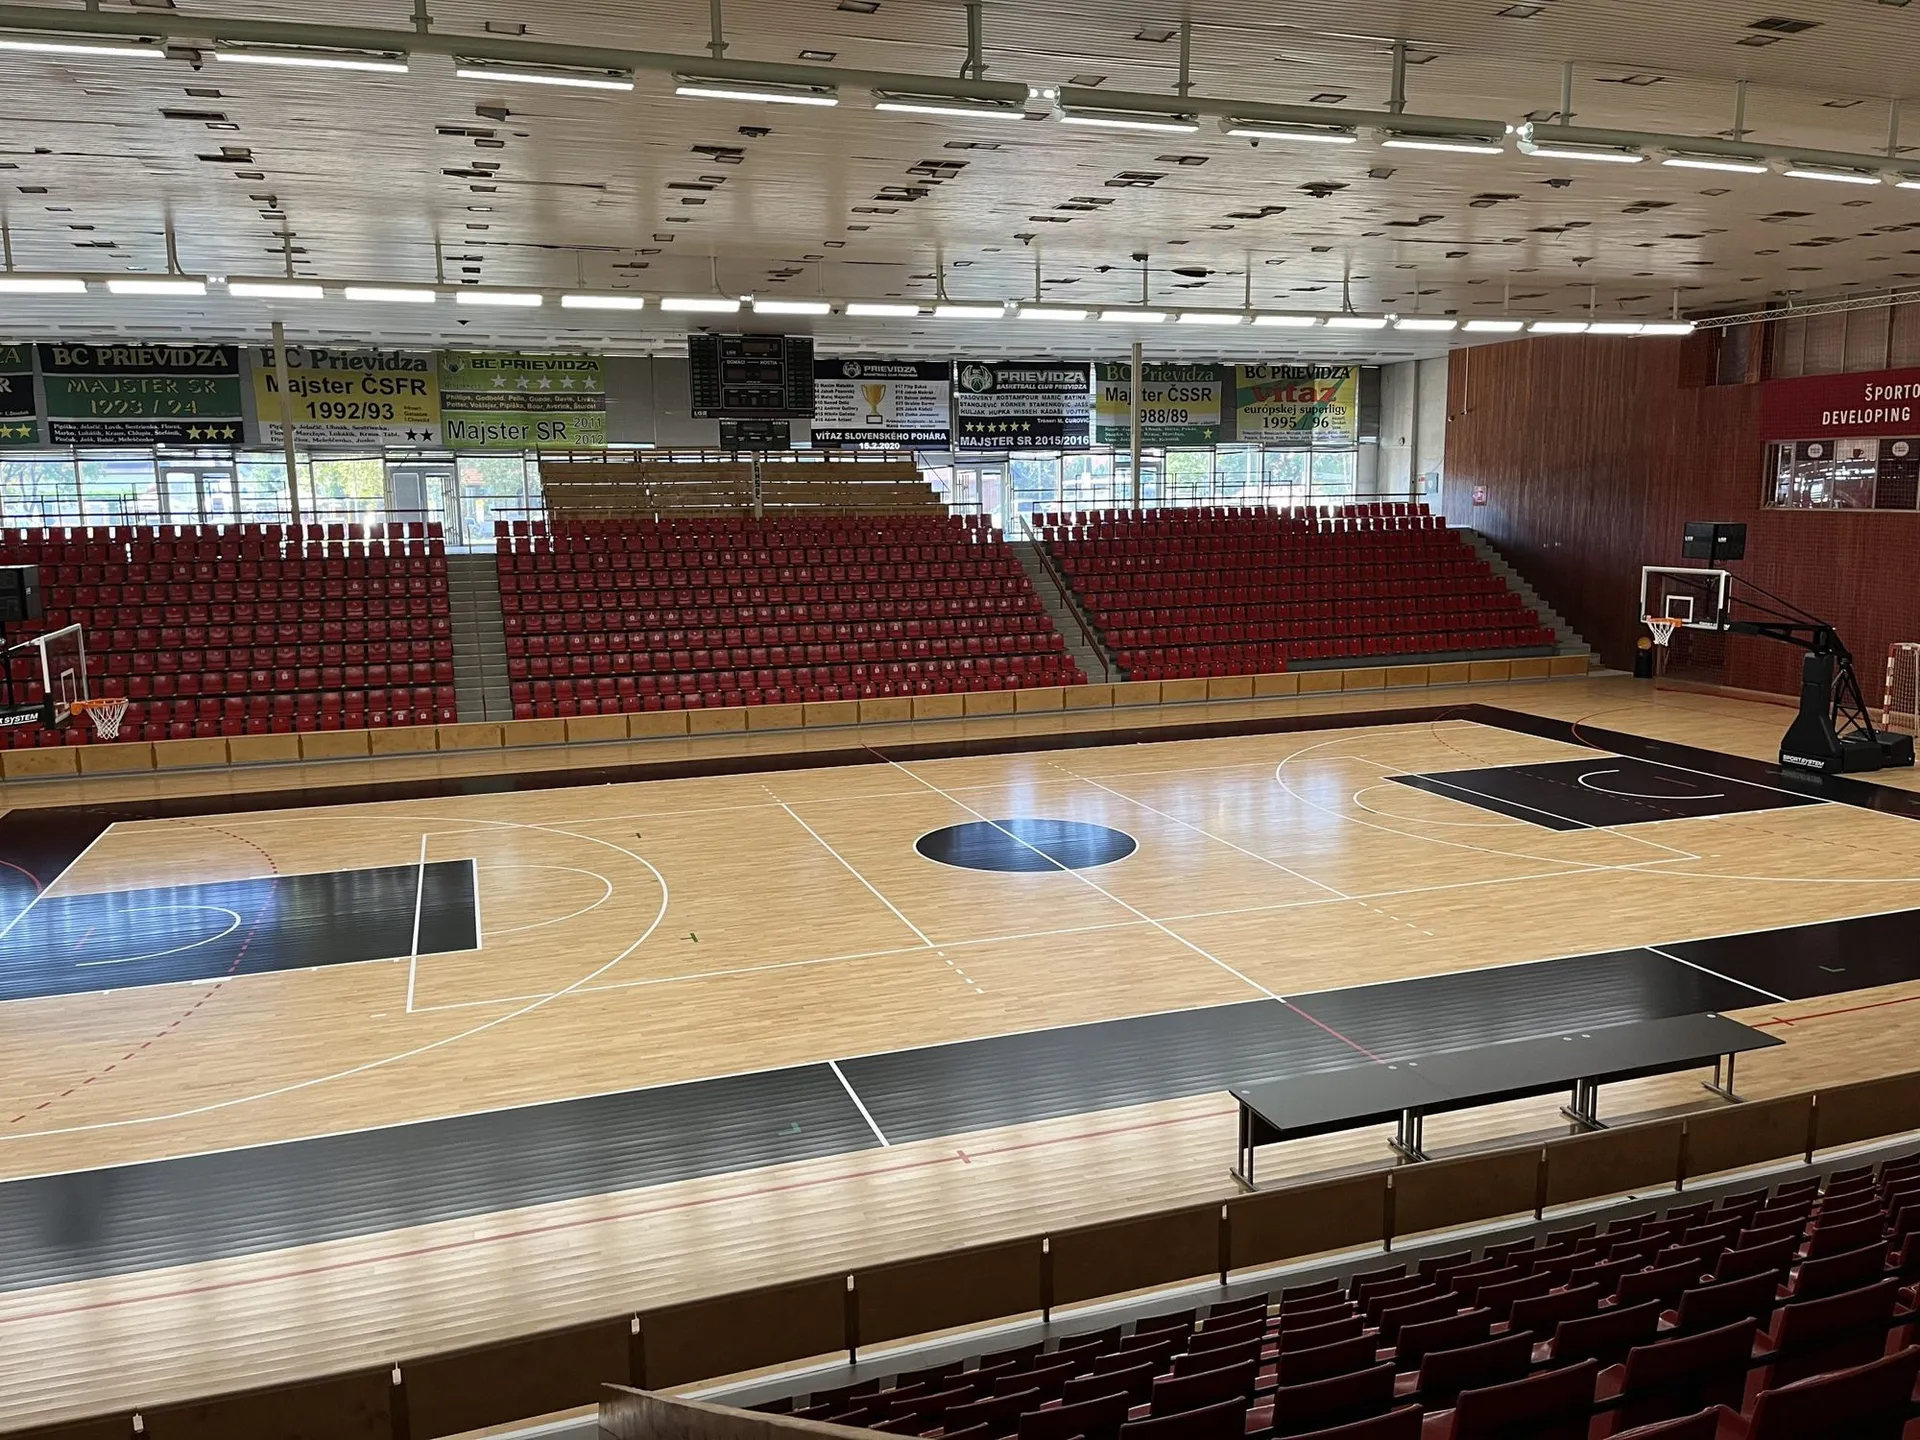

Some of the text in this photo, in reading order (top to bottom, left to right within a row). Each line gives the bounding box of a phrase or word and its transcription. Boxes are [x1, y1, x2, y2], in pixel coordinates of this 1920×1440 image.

[52, 348, 228, 367] BC PRIEVIDZA
[260, 348, 428, 372] BC Prievidza
[471, 358, 599, 371] BC PRIEVIDZA
[863, 365, 917, 374] PRIEVIDZA
[997, 370, 1087, 383] PRIEVIDZA
[1106, 365, 1131, 381] BC
[1244, 365, 1350, 380] BC PRIEVIDZA
[67, 379, 217, 394] MAJSTER SR
[266, 373, 427, 398] Majster ČSFR
[1105, 384, 1212, 406] Majter ČSSR
[306, 401, 395, 420] 1992/93
[1244, 403, 1347, 416] európskej superligy
[1822, 406, 1911, 425] DEVELOPING
[573, 417, 602, 428] 2011
[1263, 416, 1297, 429] 1995
[1312, 417, 1329, 429] 96
[447, 420, 567, 445] Majster SR
[574, 434, 604, 445] 2012
[815, 431, 947, 441] VÍŤAZ SLOVENSKÉHO POHÁRA
[960, 435, 1090, 446] MAJSTER SR 2015/2016
